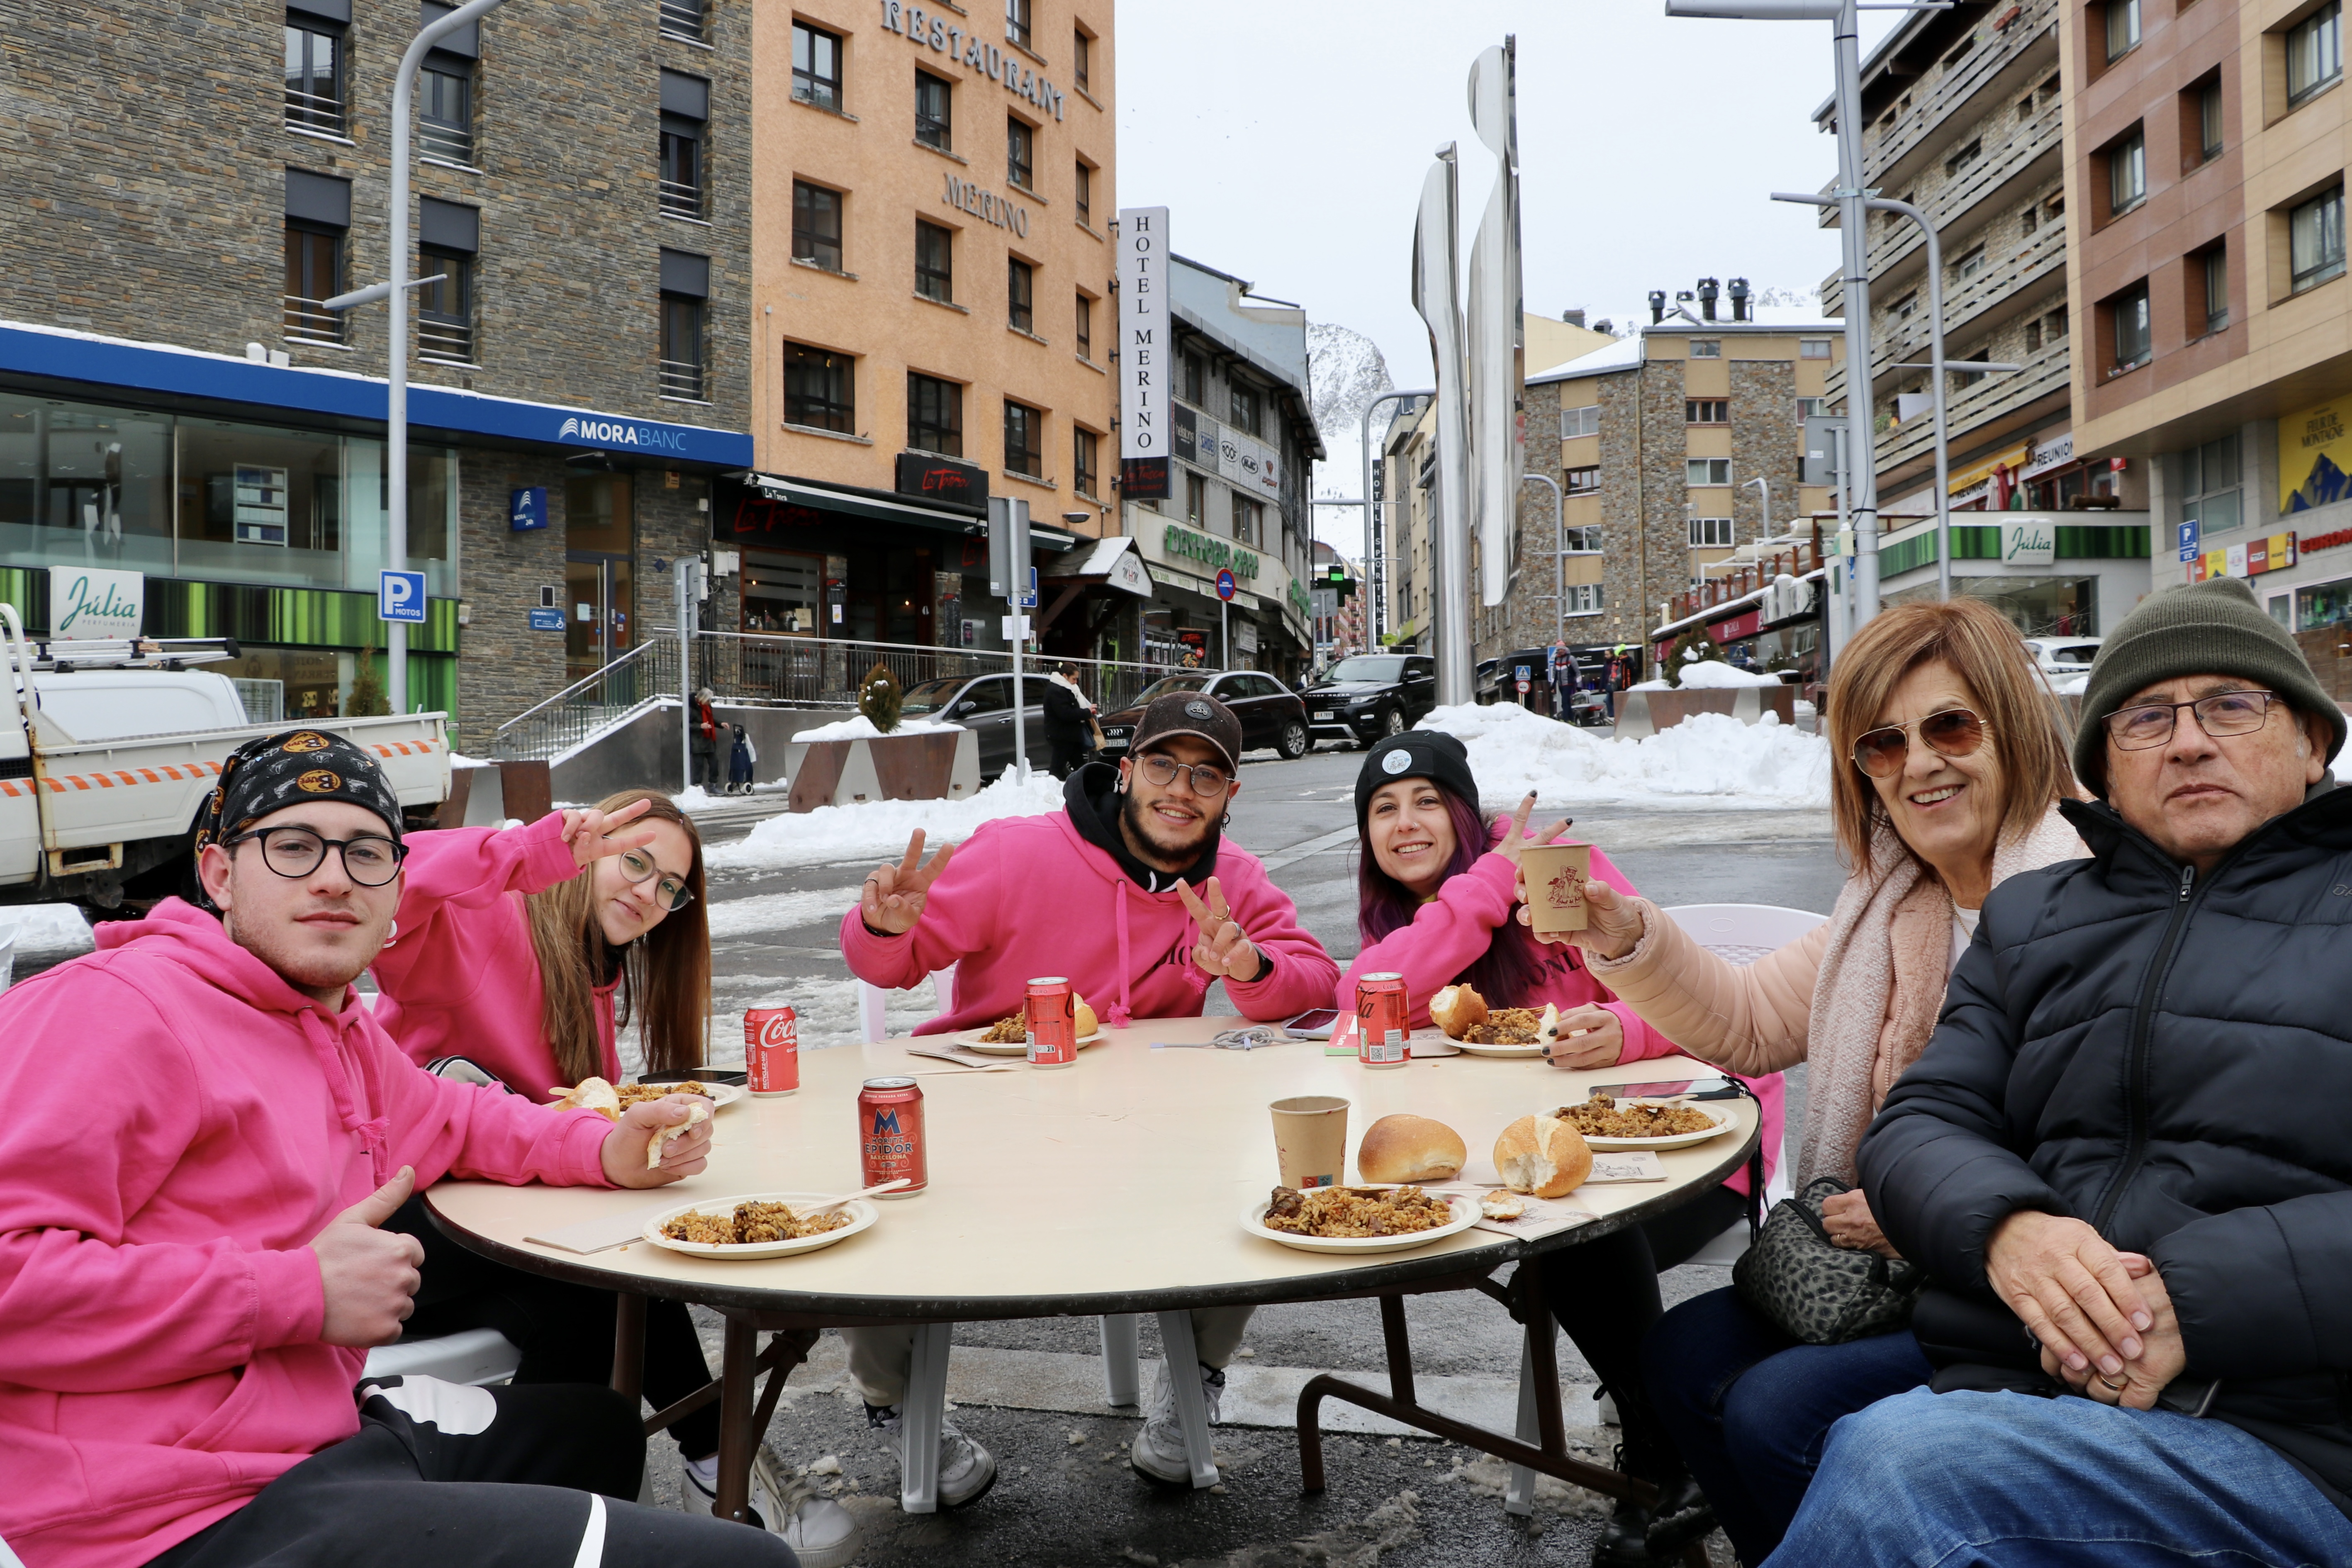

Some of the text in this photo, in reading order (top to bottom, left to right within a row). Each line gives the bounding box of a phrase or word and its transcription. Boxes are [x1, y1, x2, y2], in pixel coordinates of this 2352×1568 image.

[882, 0, 1066, 122] RESTAURANT
[943, 172, 1030, 239] MERINO
[1135, 216, 1153, 448] HOTEL MERINO
[1244, 458, 1256, 470] HJC
[765, 487, 787, 501] La Tasca
[2008, 527, 2052, 560] Júlia
[2183, 528, 2191, 541] P
[1167, 525, 1259, 579] DAYTONA 2000
[59, 576, 136, 631] Júlia
[384, 575, 412, 614] P
[82, 619, 135, 628] PERFUMERIA
[395, 608, 421, 617] MOTOS
[1337, 1035, 1347, 1045] APLI
[865, 1143, 913, 1154] EPIDOR
